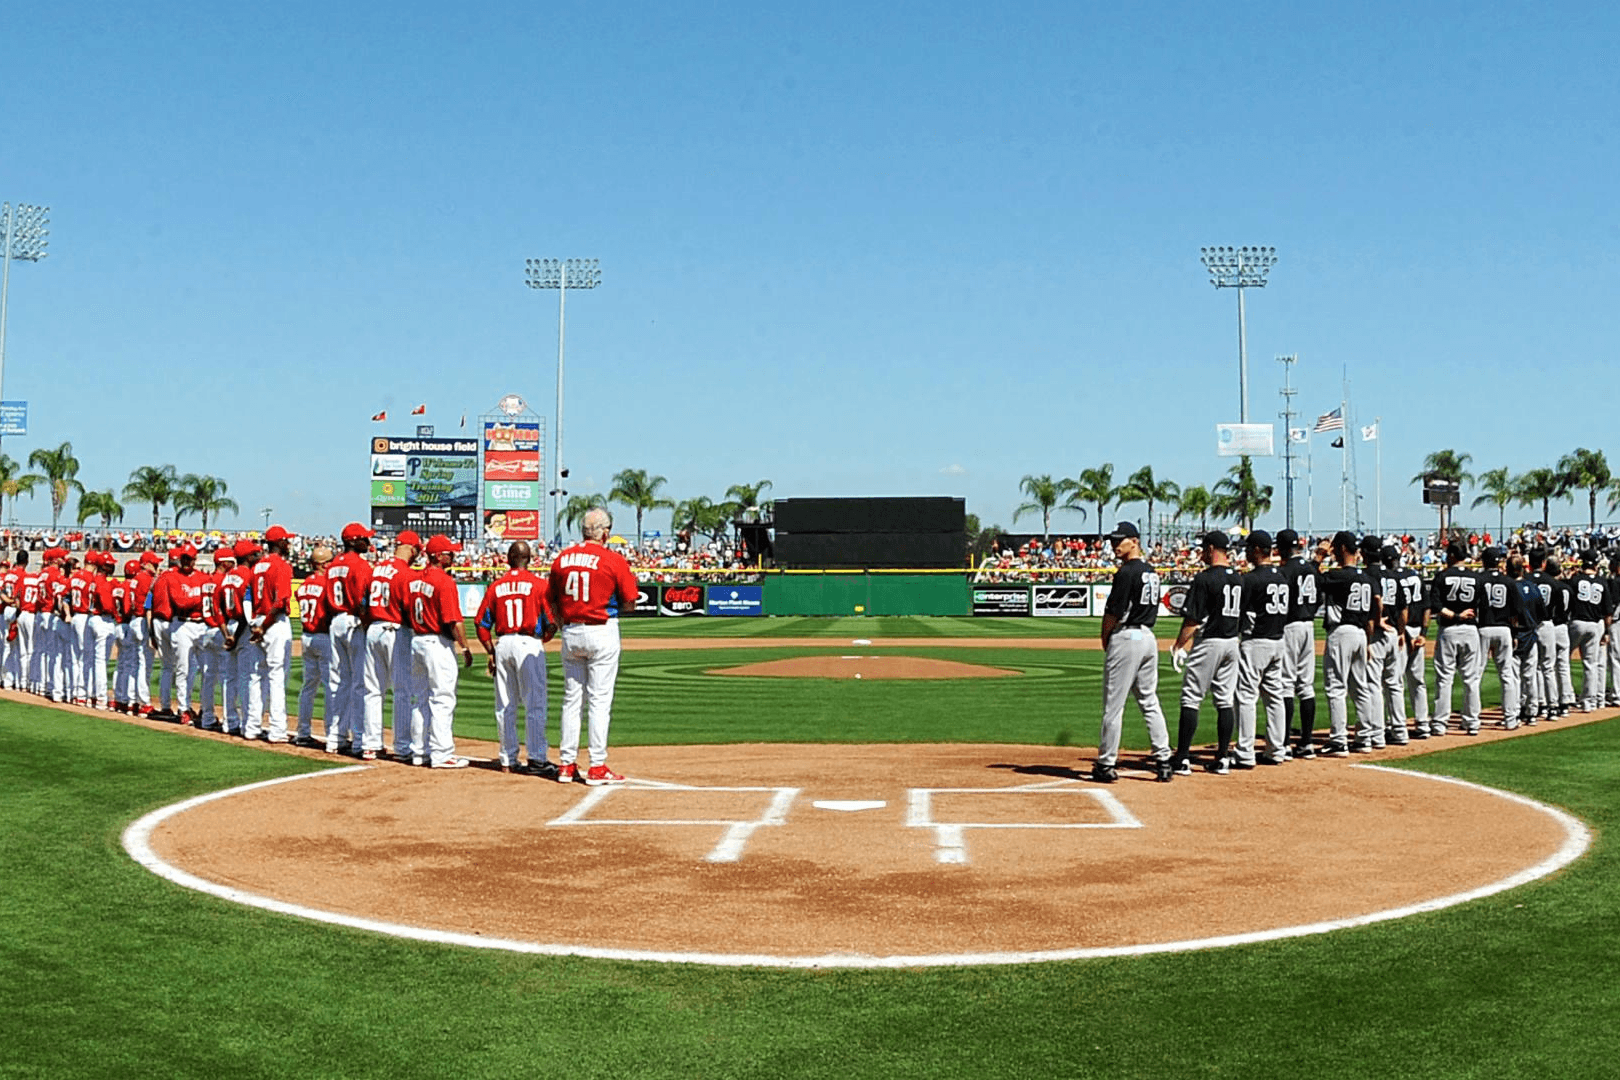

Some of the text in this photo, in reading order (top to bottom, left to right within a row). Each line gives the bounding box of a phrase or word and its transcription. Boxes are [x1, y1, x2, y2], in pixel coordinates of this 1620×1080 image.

[389, 441, 477, 452] bright house field
[419, 469, 455, 481] Spring
[491, 485, 531, 500] Times
[560, 552, 600, 570] MANUEL
[565, 571, 590, 602] 41
[1266, 583, 1290, 615] 33
[1297, 574, 1317, 605] 14
[1346, 582, 1372, 612] 20
[1445, 576, 1476, 603] 75
[1485, 582, 1507, 609] 19
[1577, 579, 1604, 605] 96
[505, 598, 523, 629] 11
[1222, 584, 1242, 617] 11
